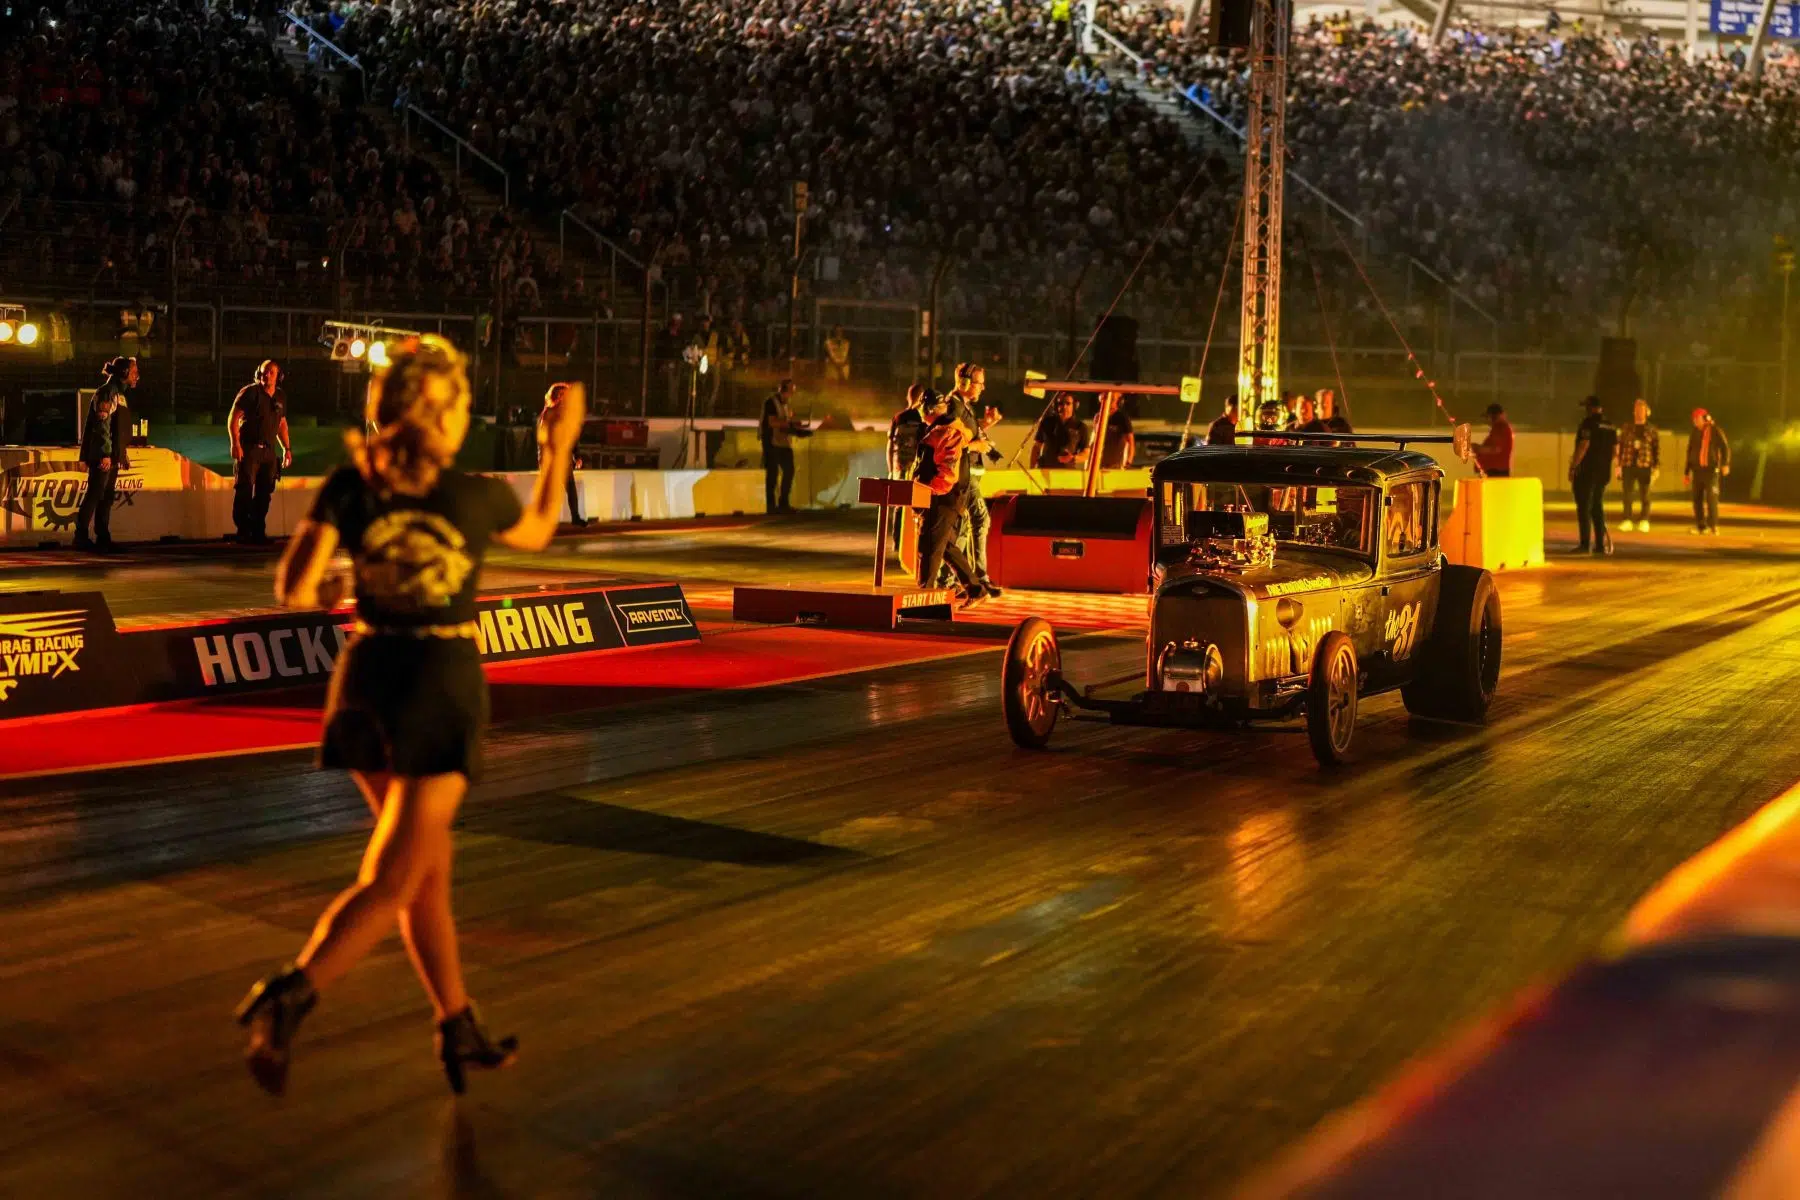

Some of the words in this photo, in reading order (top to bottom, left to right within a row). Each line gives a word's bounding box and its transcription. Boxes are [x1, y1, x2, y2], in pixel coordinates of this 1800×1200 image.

[115, 478, 144, 489] ACING
[902, 593, 928, 608] START
[929, 591, 947, 605] LINE
[628, 608, 683, 625] RAVENOL
[1385, 609, 1401, 641] the
[1392, 600, 1421, 661] 31
[0, 638, 31, 654] RAG
[34, 634, 84, 652] RACING
